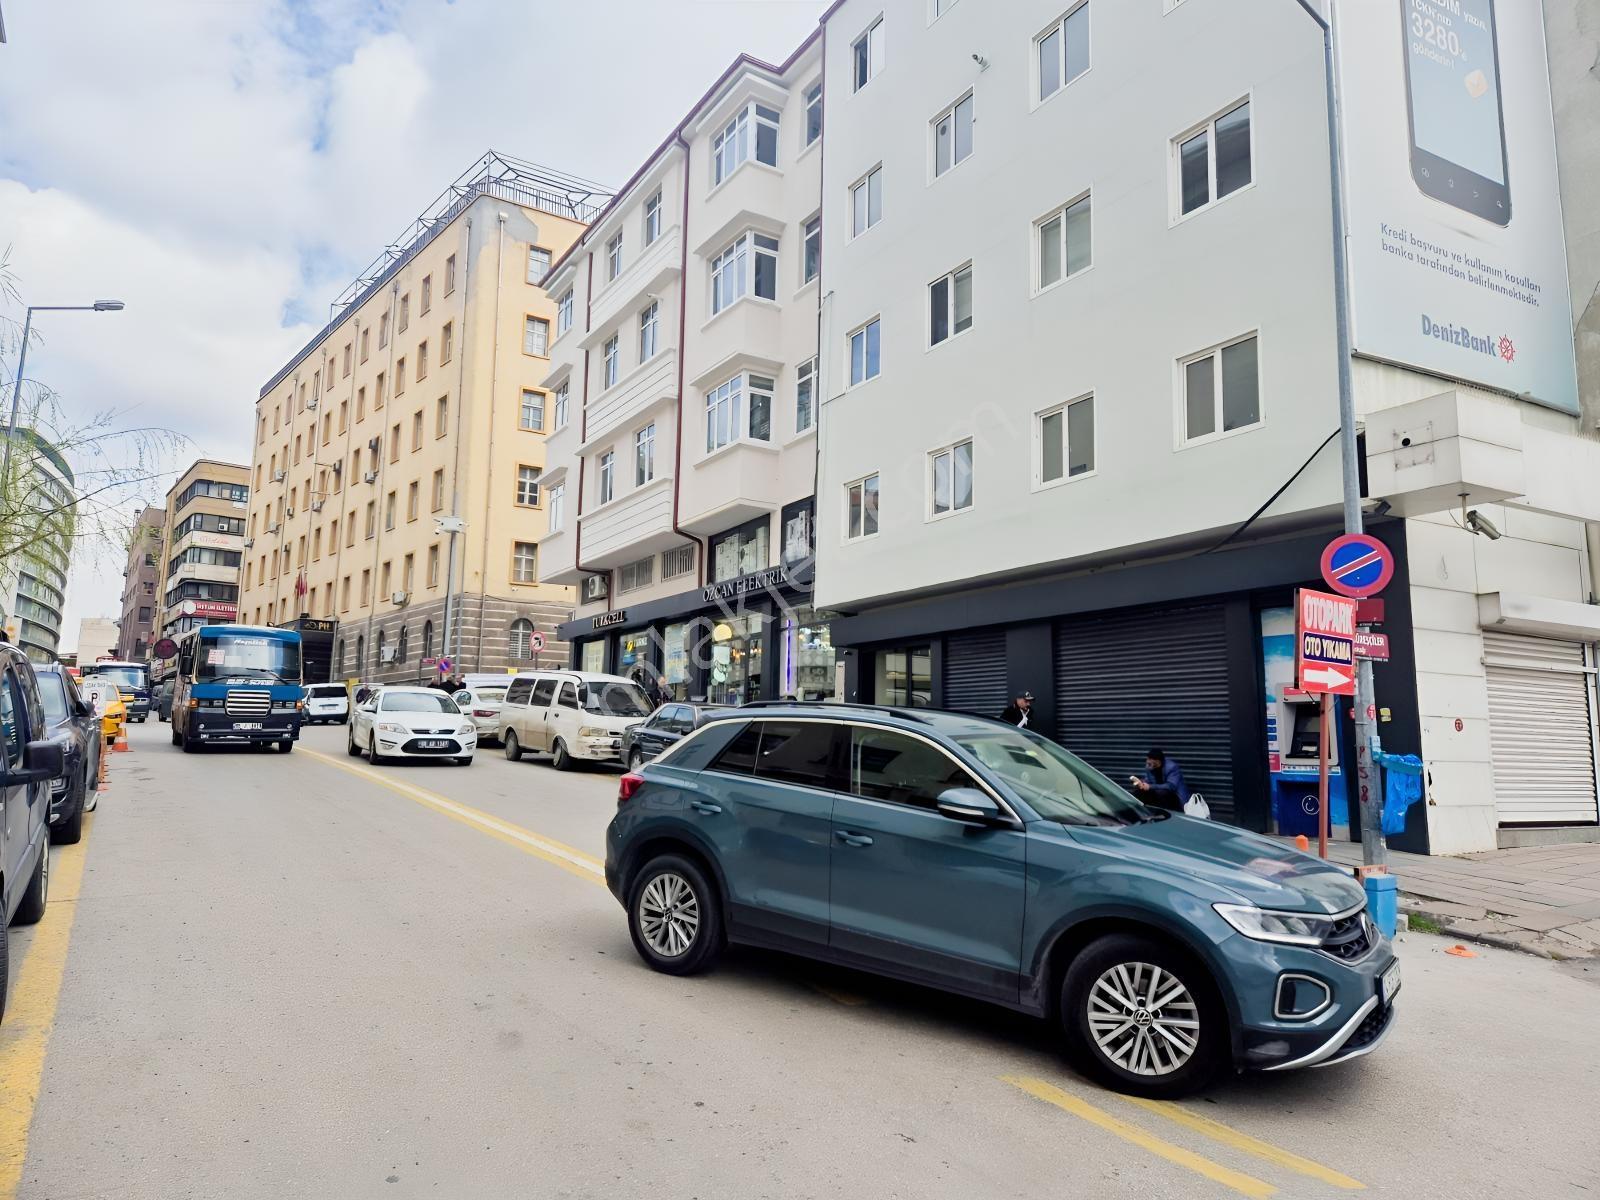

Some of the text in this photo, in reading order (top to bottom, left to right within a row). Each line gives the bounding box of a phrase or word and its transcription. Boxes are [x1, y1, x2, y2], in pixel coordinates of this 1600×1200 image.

[1380, 222, 1407, 242] Kredi
[1410, 233, 1448, 259] başvuru
[1451, 251, 1462, 264] ve
[1381, 239, 1414, 261] banka
[1416, 254, 1466, 280] tarafından
[1421, 314, 1497, 357] DenizBank
[1304, 595, 1353, 635] OTOPARK
[1304, 636, 1352, 661] OTO YIKAMA
